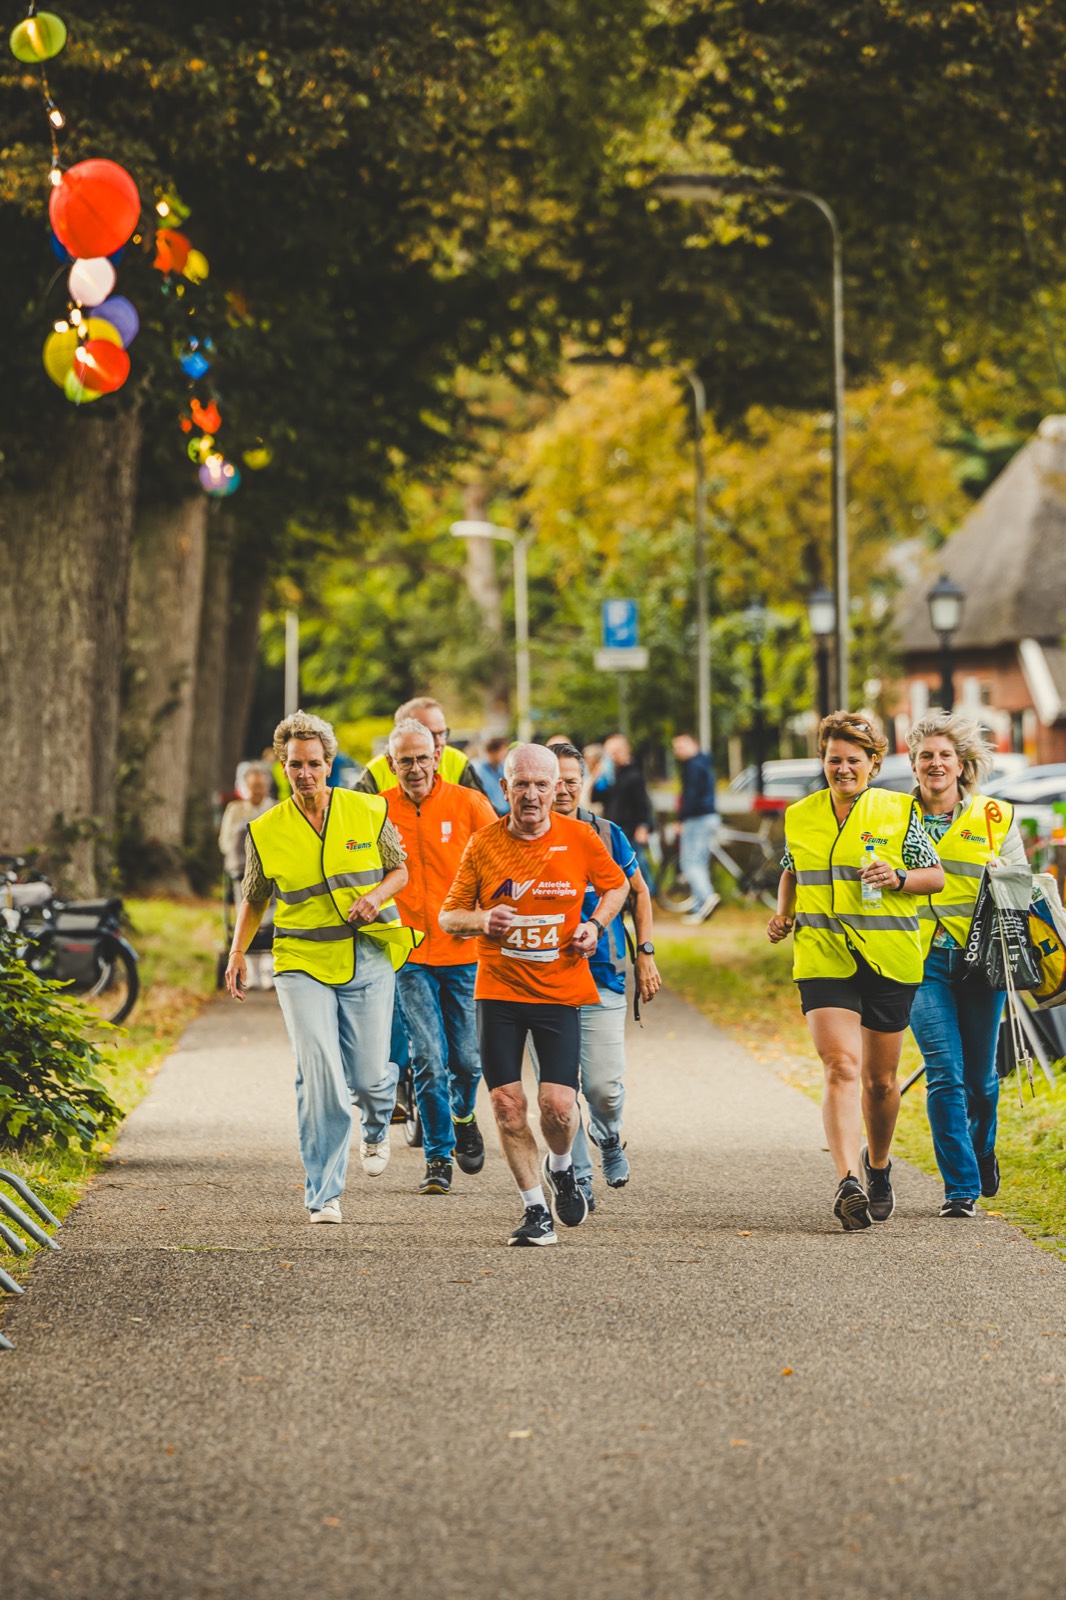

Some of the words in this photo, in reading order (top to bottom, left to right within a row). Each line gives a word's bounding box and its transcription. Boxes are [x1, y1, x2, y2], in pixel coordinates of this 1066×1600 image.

[491, 878, 537, 901] AV
[532, 888, 577, 897] Vereniging
[538, 881, 571, 889] Atletiek
[506, 926, 560, 949] 454
[963, 921, 982, 961] baan
